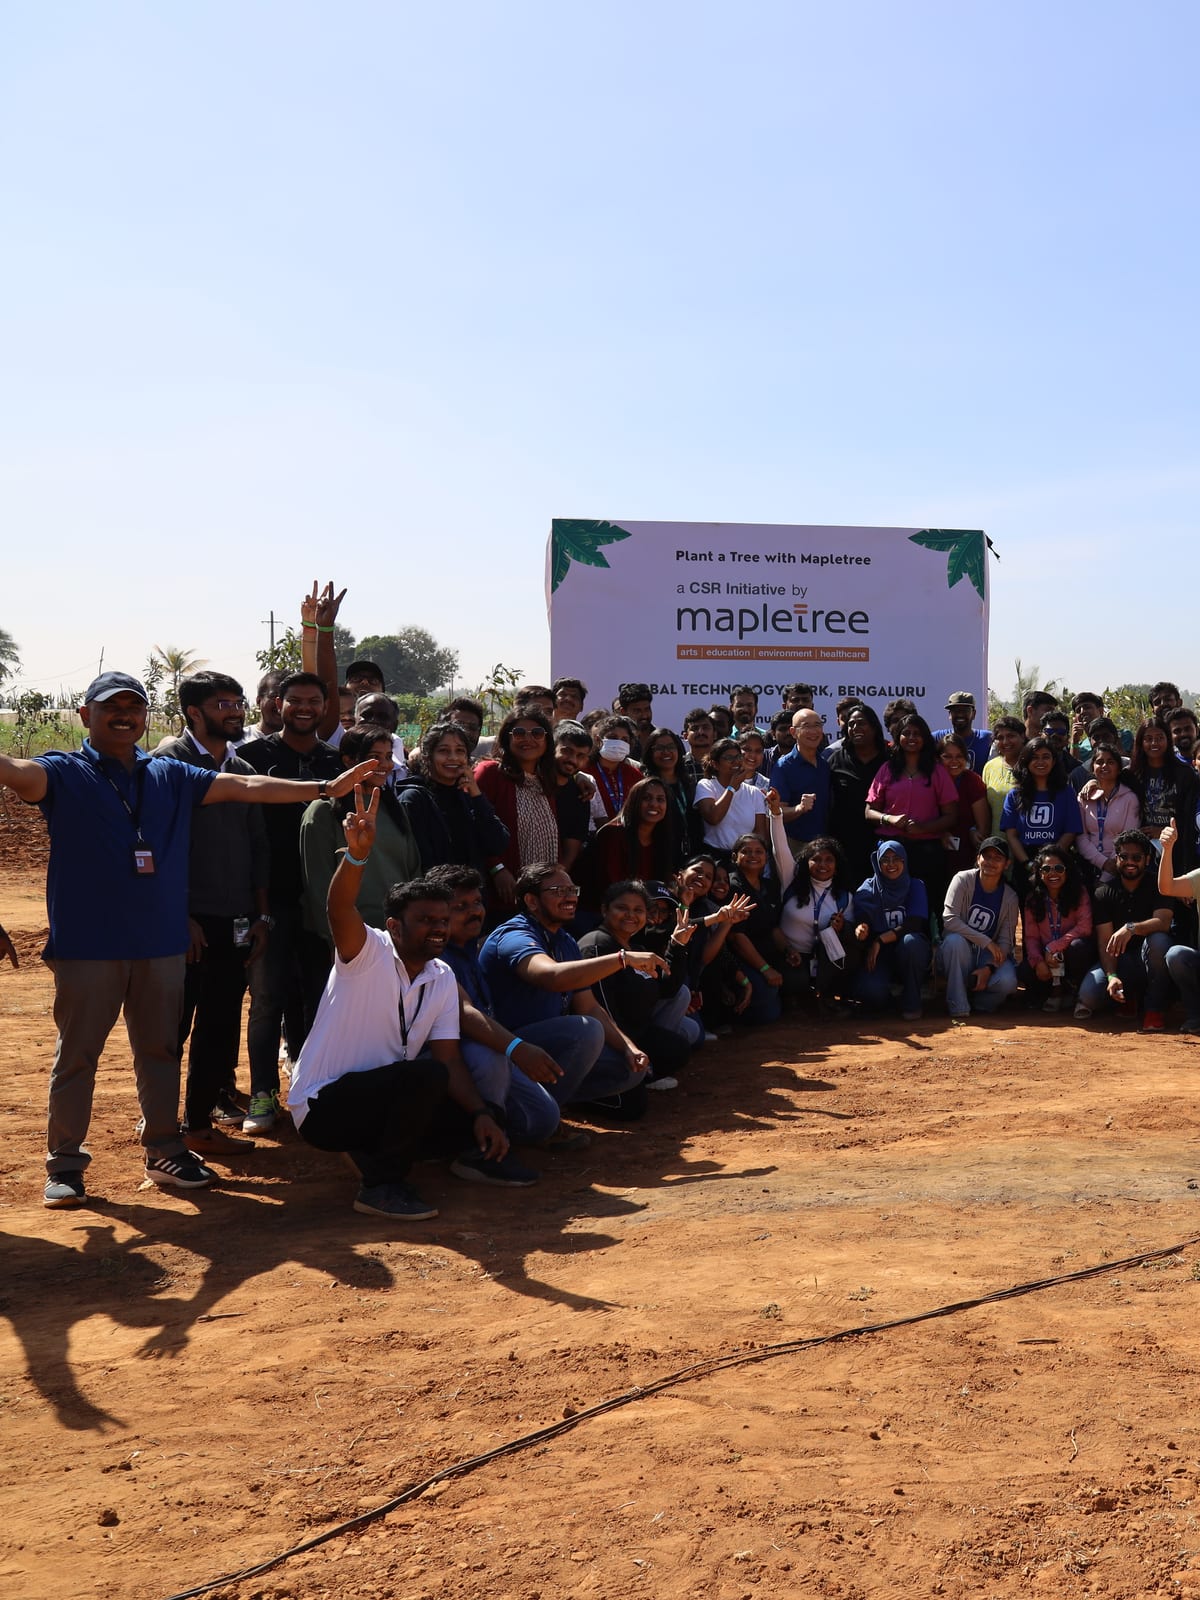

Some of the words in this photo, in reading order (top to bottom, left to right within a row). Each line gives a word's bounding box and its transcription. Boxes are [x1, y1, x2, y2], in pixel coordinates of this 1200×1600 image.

[676, 551, 713, 561] Plant
[718, 553, 726, 562] a
[730, 552, 760, 562] Tree
[765, 553, 796, 563] with
[801, 554, 871, 566] Mapletree
[677, 584, 685, 594] a
[690, 582, 721, 594] CSR
[726, 583, 786, 596] Initiative
[792, 584, 807, 599] by
[677, 603, 869, 640] mapletree
[680, 648, 698, 656] arts
[706, 648, 750, 658] education
[758, 649, 812, 659] environment
[820, 650, 866, 659] healthcare
[618, 683, 677, 695] BAL
[682, 684, 784, 696] TECHNOGY
[838, 686, 926, 698] BENGALURU
[1024, 831, 1055, 840] HURON
